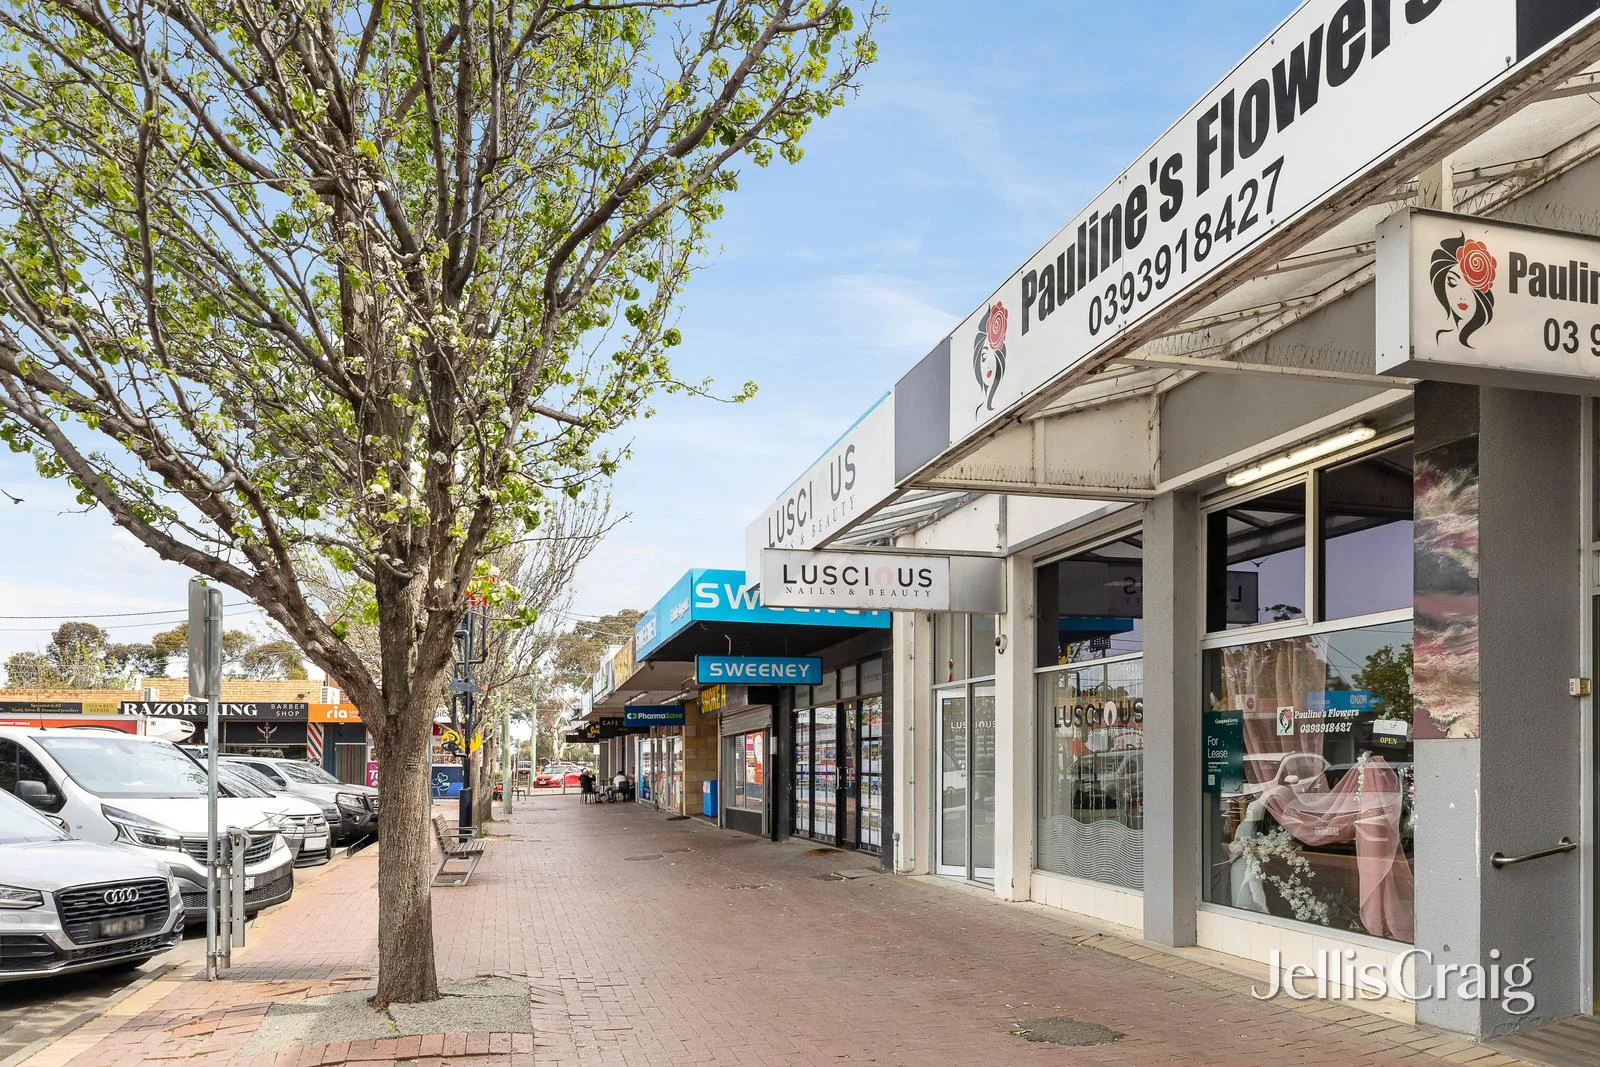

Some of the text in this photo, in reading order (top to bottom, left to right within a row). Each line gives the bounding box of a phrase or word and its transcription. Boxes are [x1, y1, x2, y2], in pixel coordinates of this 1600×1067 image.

[1021, 151, 1184, 336] Pauline's
[1088, 156, 1286, 337] 0393918427
[1543, 317, 1580, 354] 03
[785, 586, 932, 598] NAILS & BEAUTY
[709, 662, 811, 678] SWEENEY
[122, 702, 198, 716] RAZOR
[270, 703, 305, 711] BARBER
[326, 705, 348, 719] ria
[637, 711, 683, 720] PharmaSave
[1294, 708, 1360, 719] Pauline's Flowers
[1300, 722, 1353, 734] 0393918427
[1207, 735, 1219, 746] For
[1379, 736, 1399, 745] OPEN
[1207, 749, 1228, 759] Lease
